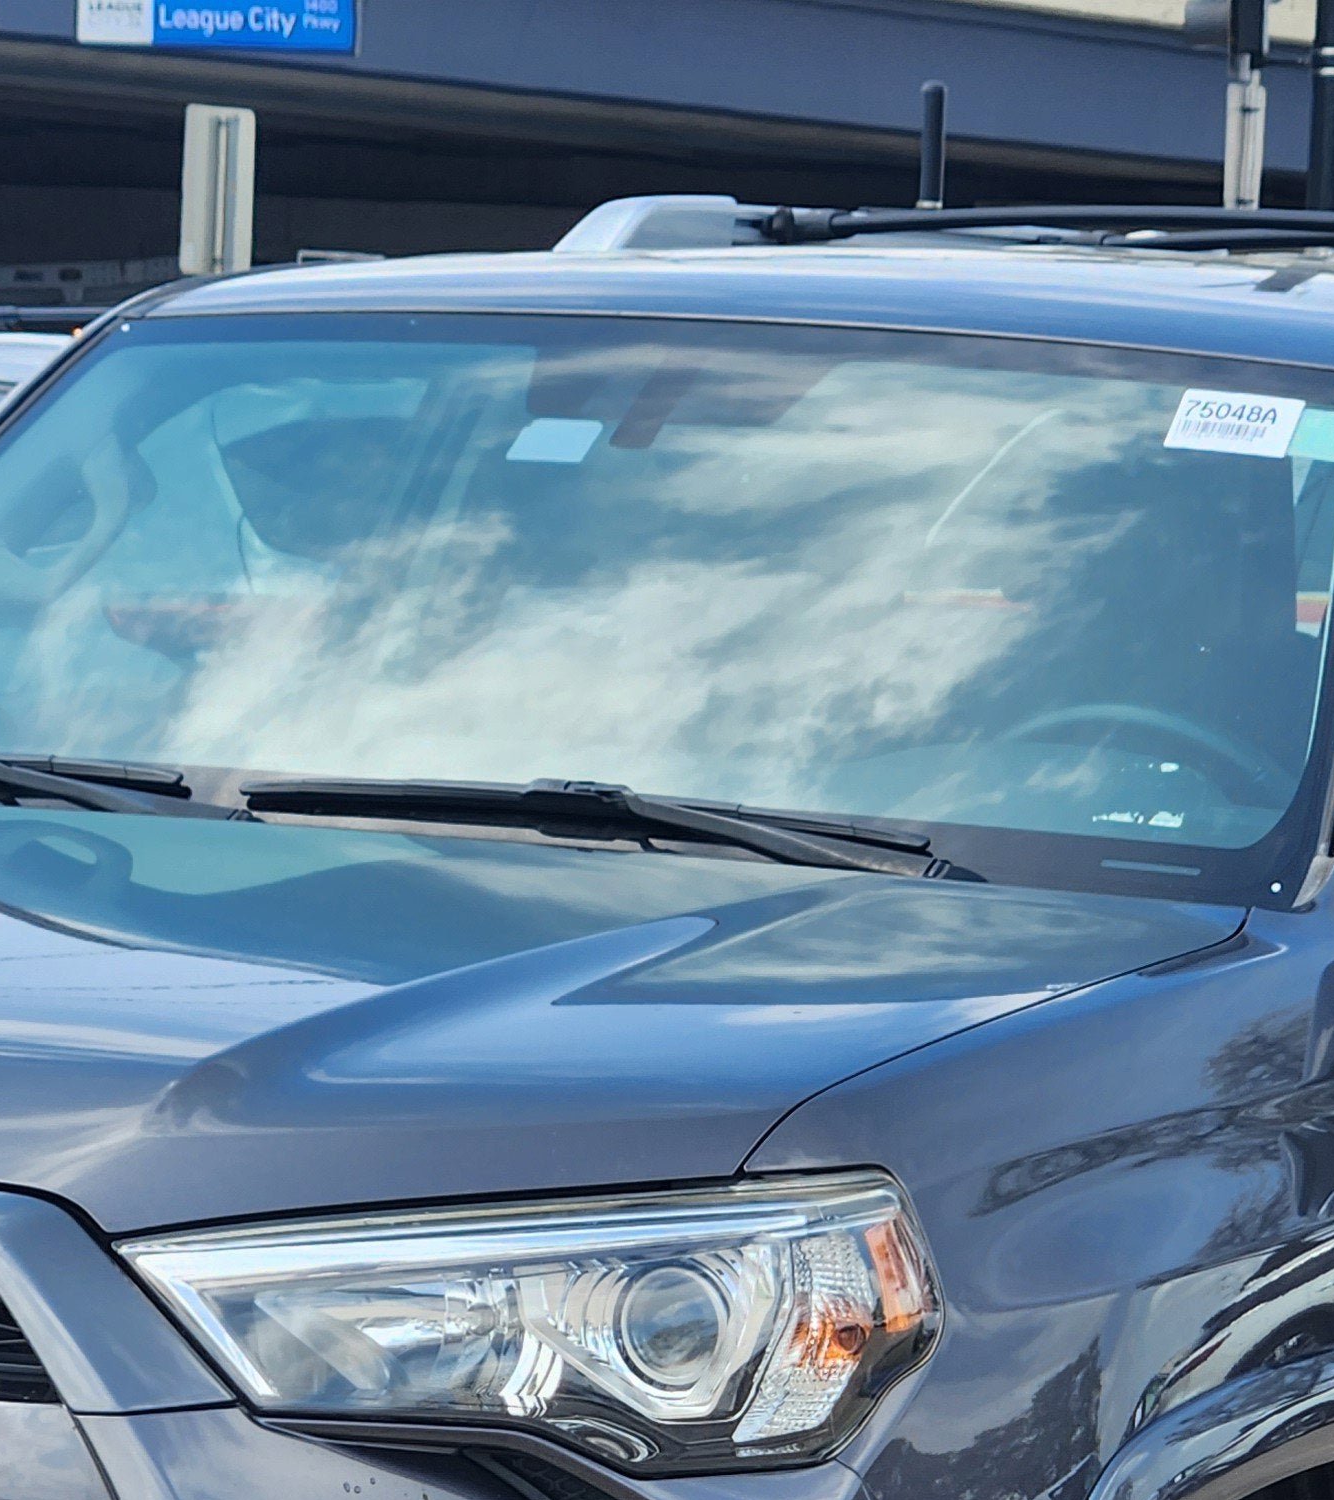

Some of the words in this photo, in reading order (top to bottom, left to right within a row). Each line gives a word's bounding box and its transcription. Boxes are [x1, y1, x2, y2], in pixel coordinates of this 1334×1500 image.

[158, 6, 244, 37] League
[247, 6, 297, 39] City
[1185, 400, 1278, 425] 75048A
